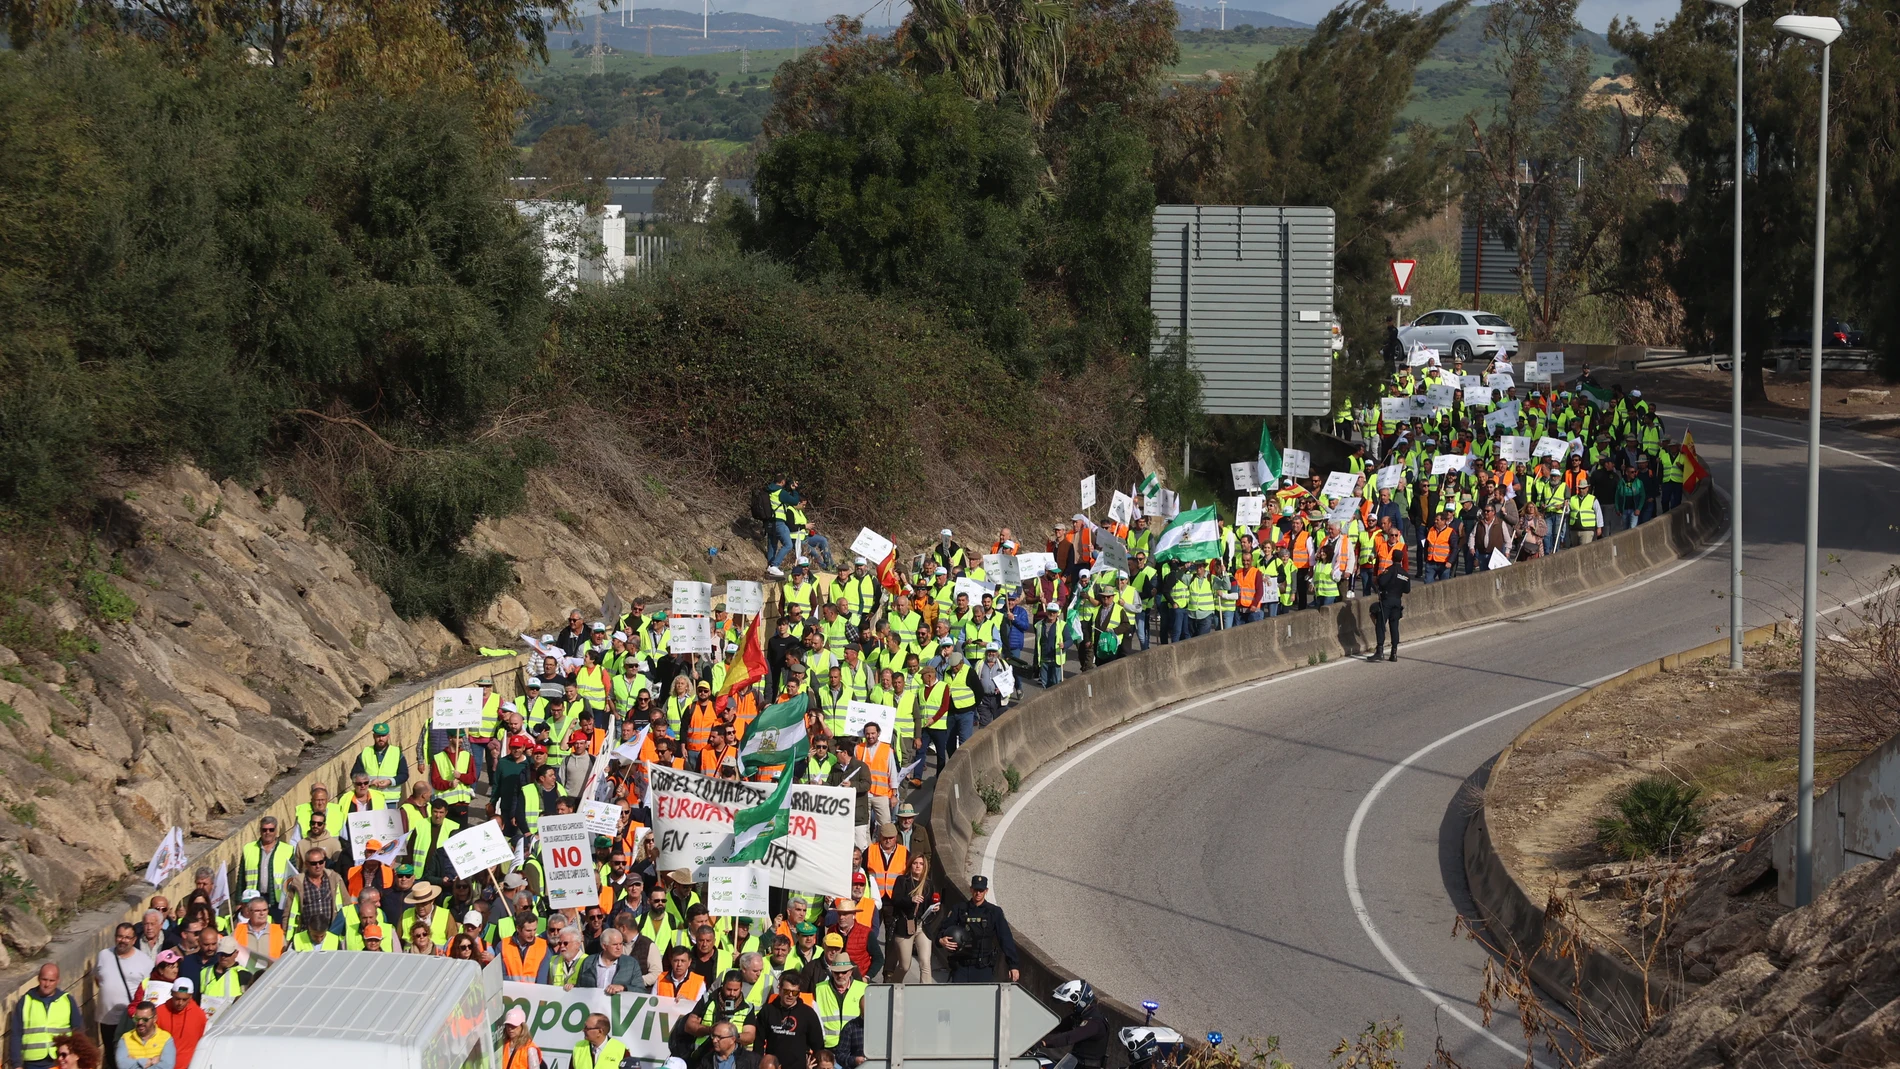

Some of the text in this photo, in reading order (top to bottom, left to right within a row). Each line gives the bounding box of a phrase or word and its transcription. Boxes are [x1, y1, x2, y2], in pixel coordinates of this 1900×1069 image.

[658, 796, 722, 821] EUROPA
[790, 791, 850, 816] ARRUECOS
[552, 846, 582, 868] NO
[502, 993, 685, 1043] mpo Viv
